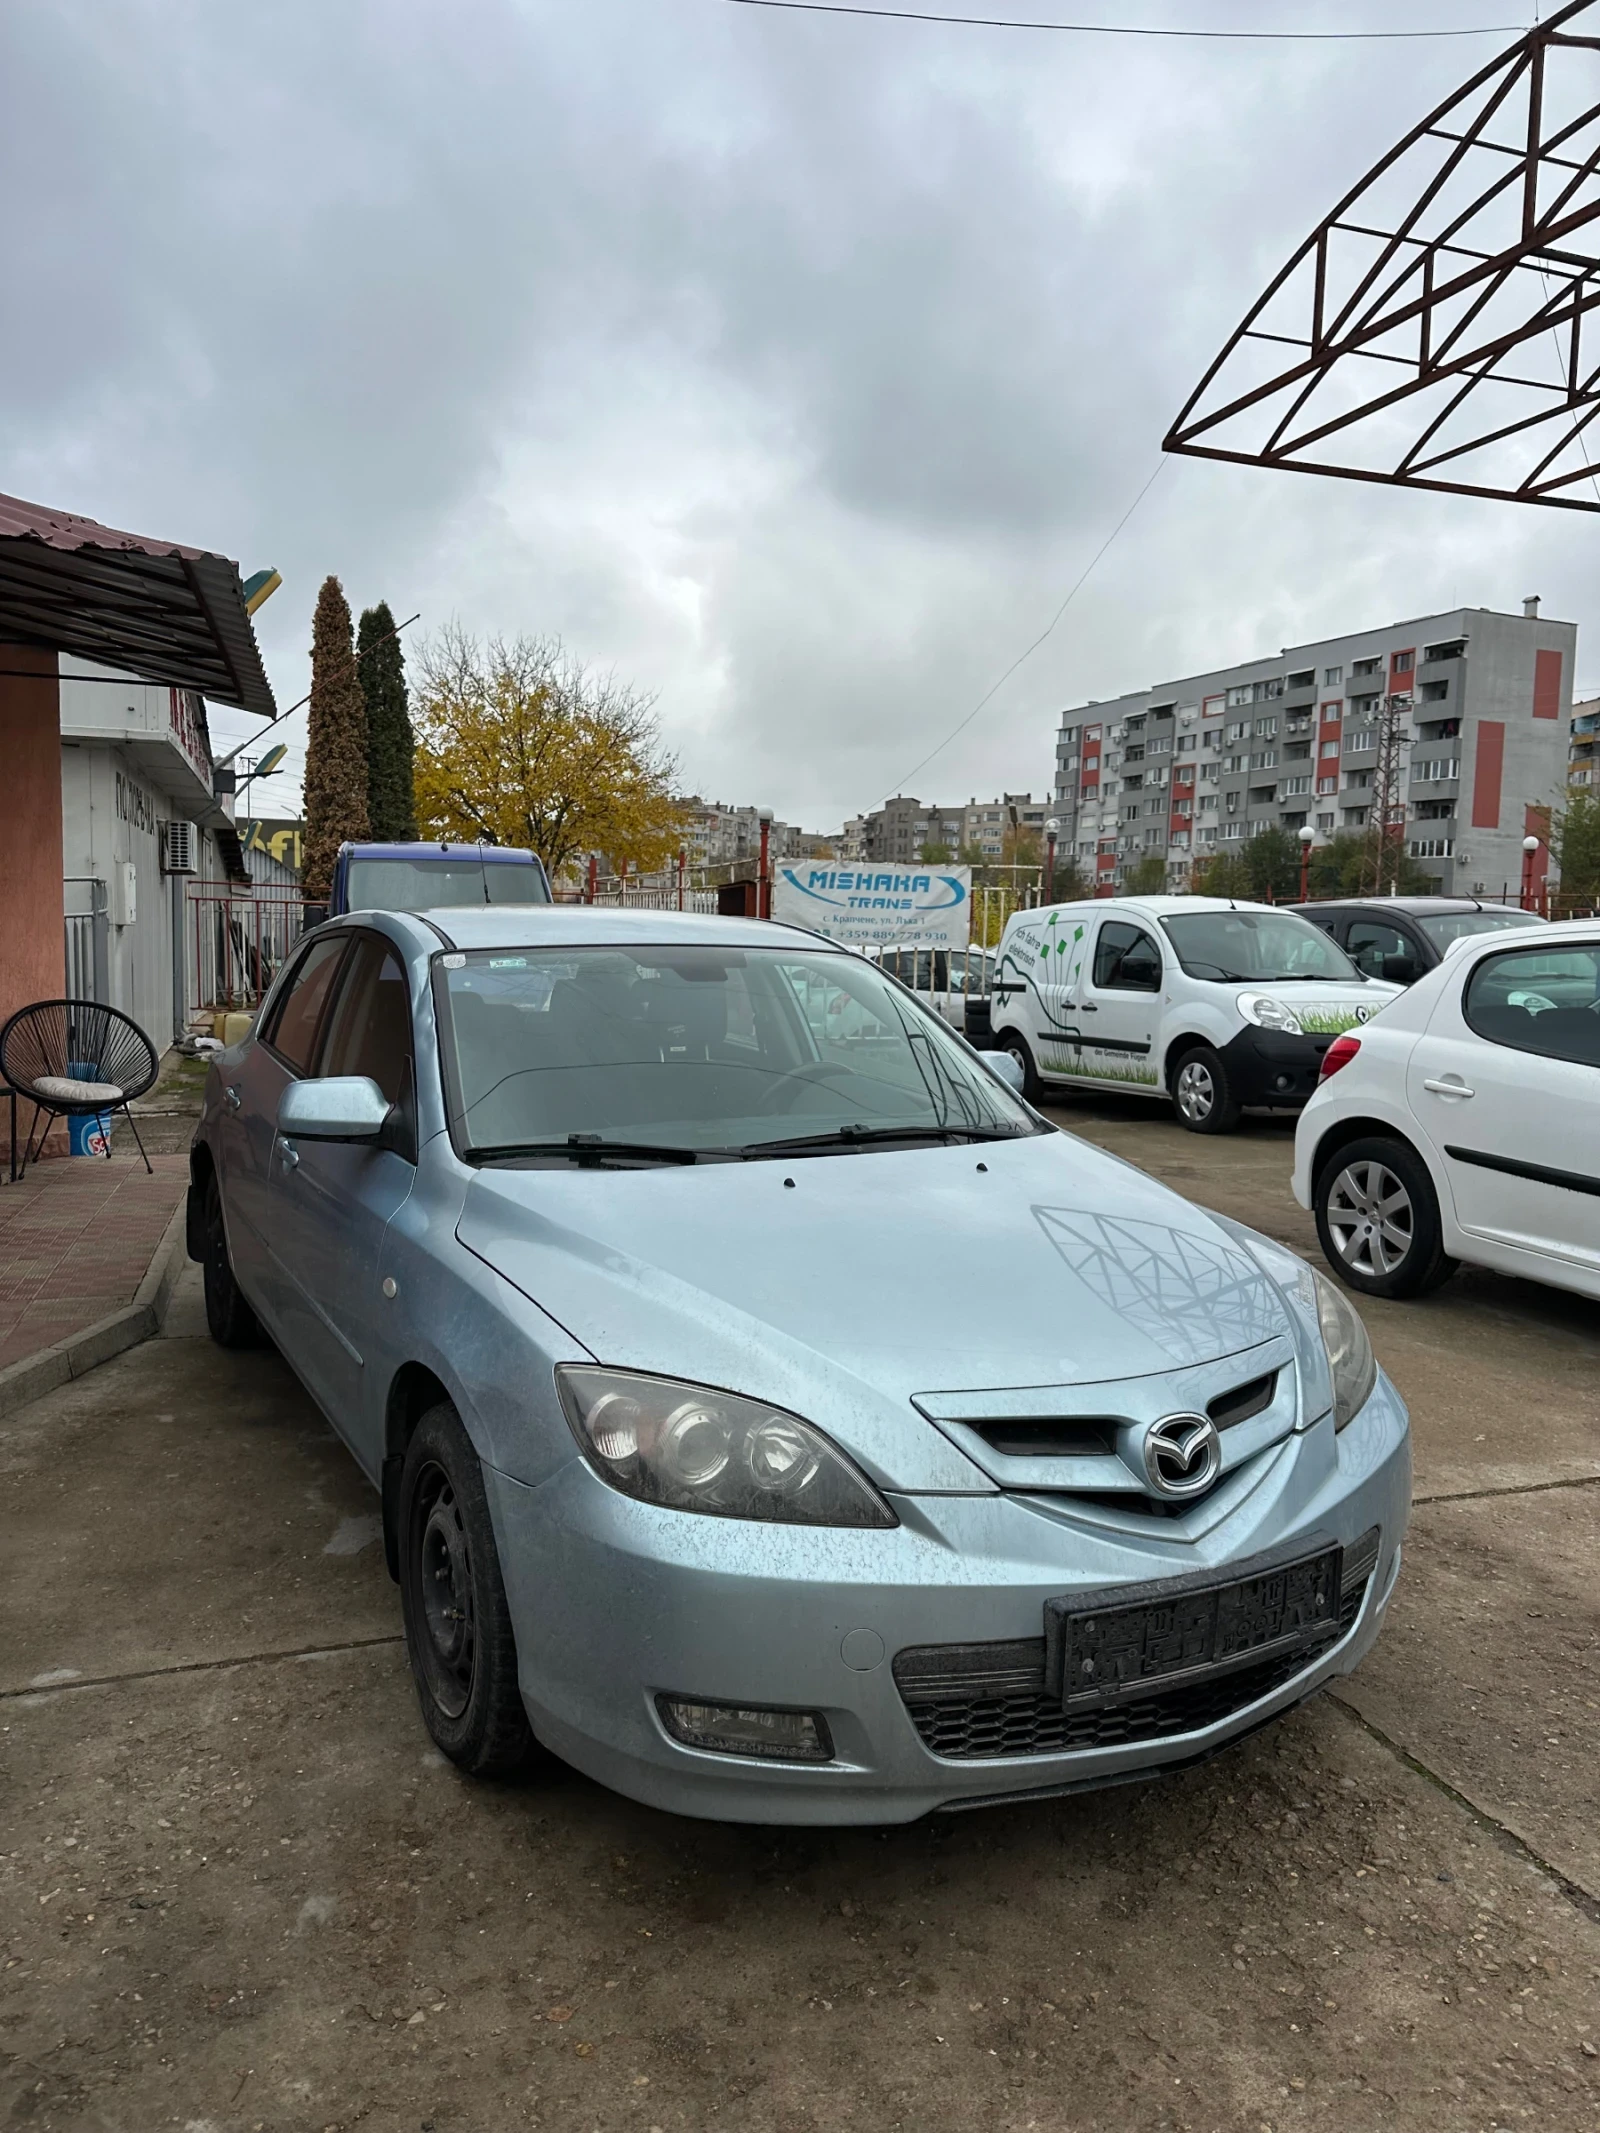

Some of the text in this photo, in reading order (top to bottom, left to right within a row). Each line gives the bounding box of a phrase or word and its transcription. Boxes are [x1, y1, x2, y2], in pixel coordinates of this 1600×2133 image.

[808, 871, 931, 893] MISHAKA
[847, 896, 913, 910] TRANS
[838, 930, 947, 941] +359 889 778 930
[1025, 932, 1041, 950] fahre
[1009, 943, 1036, 967] elektrisch
